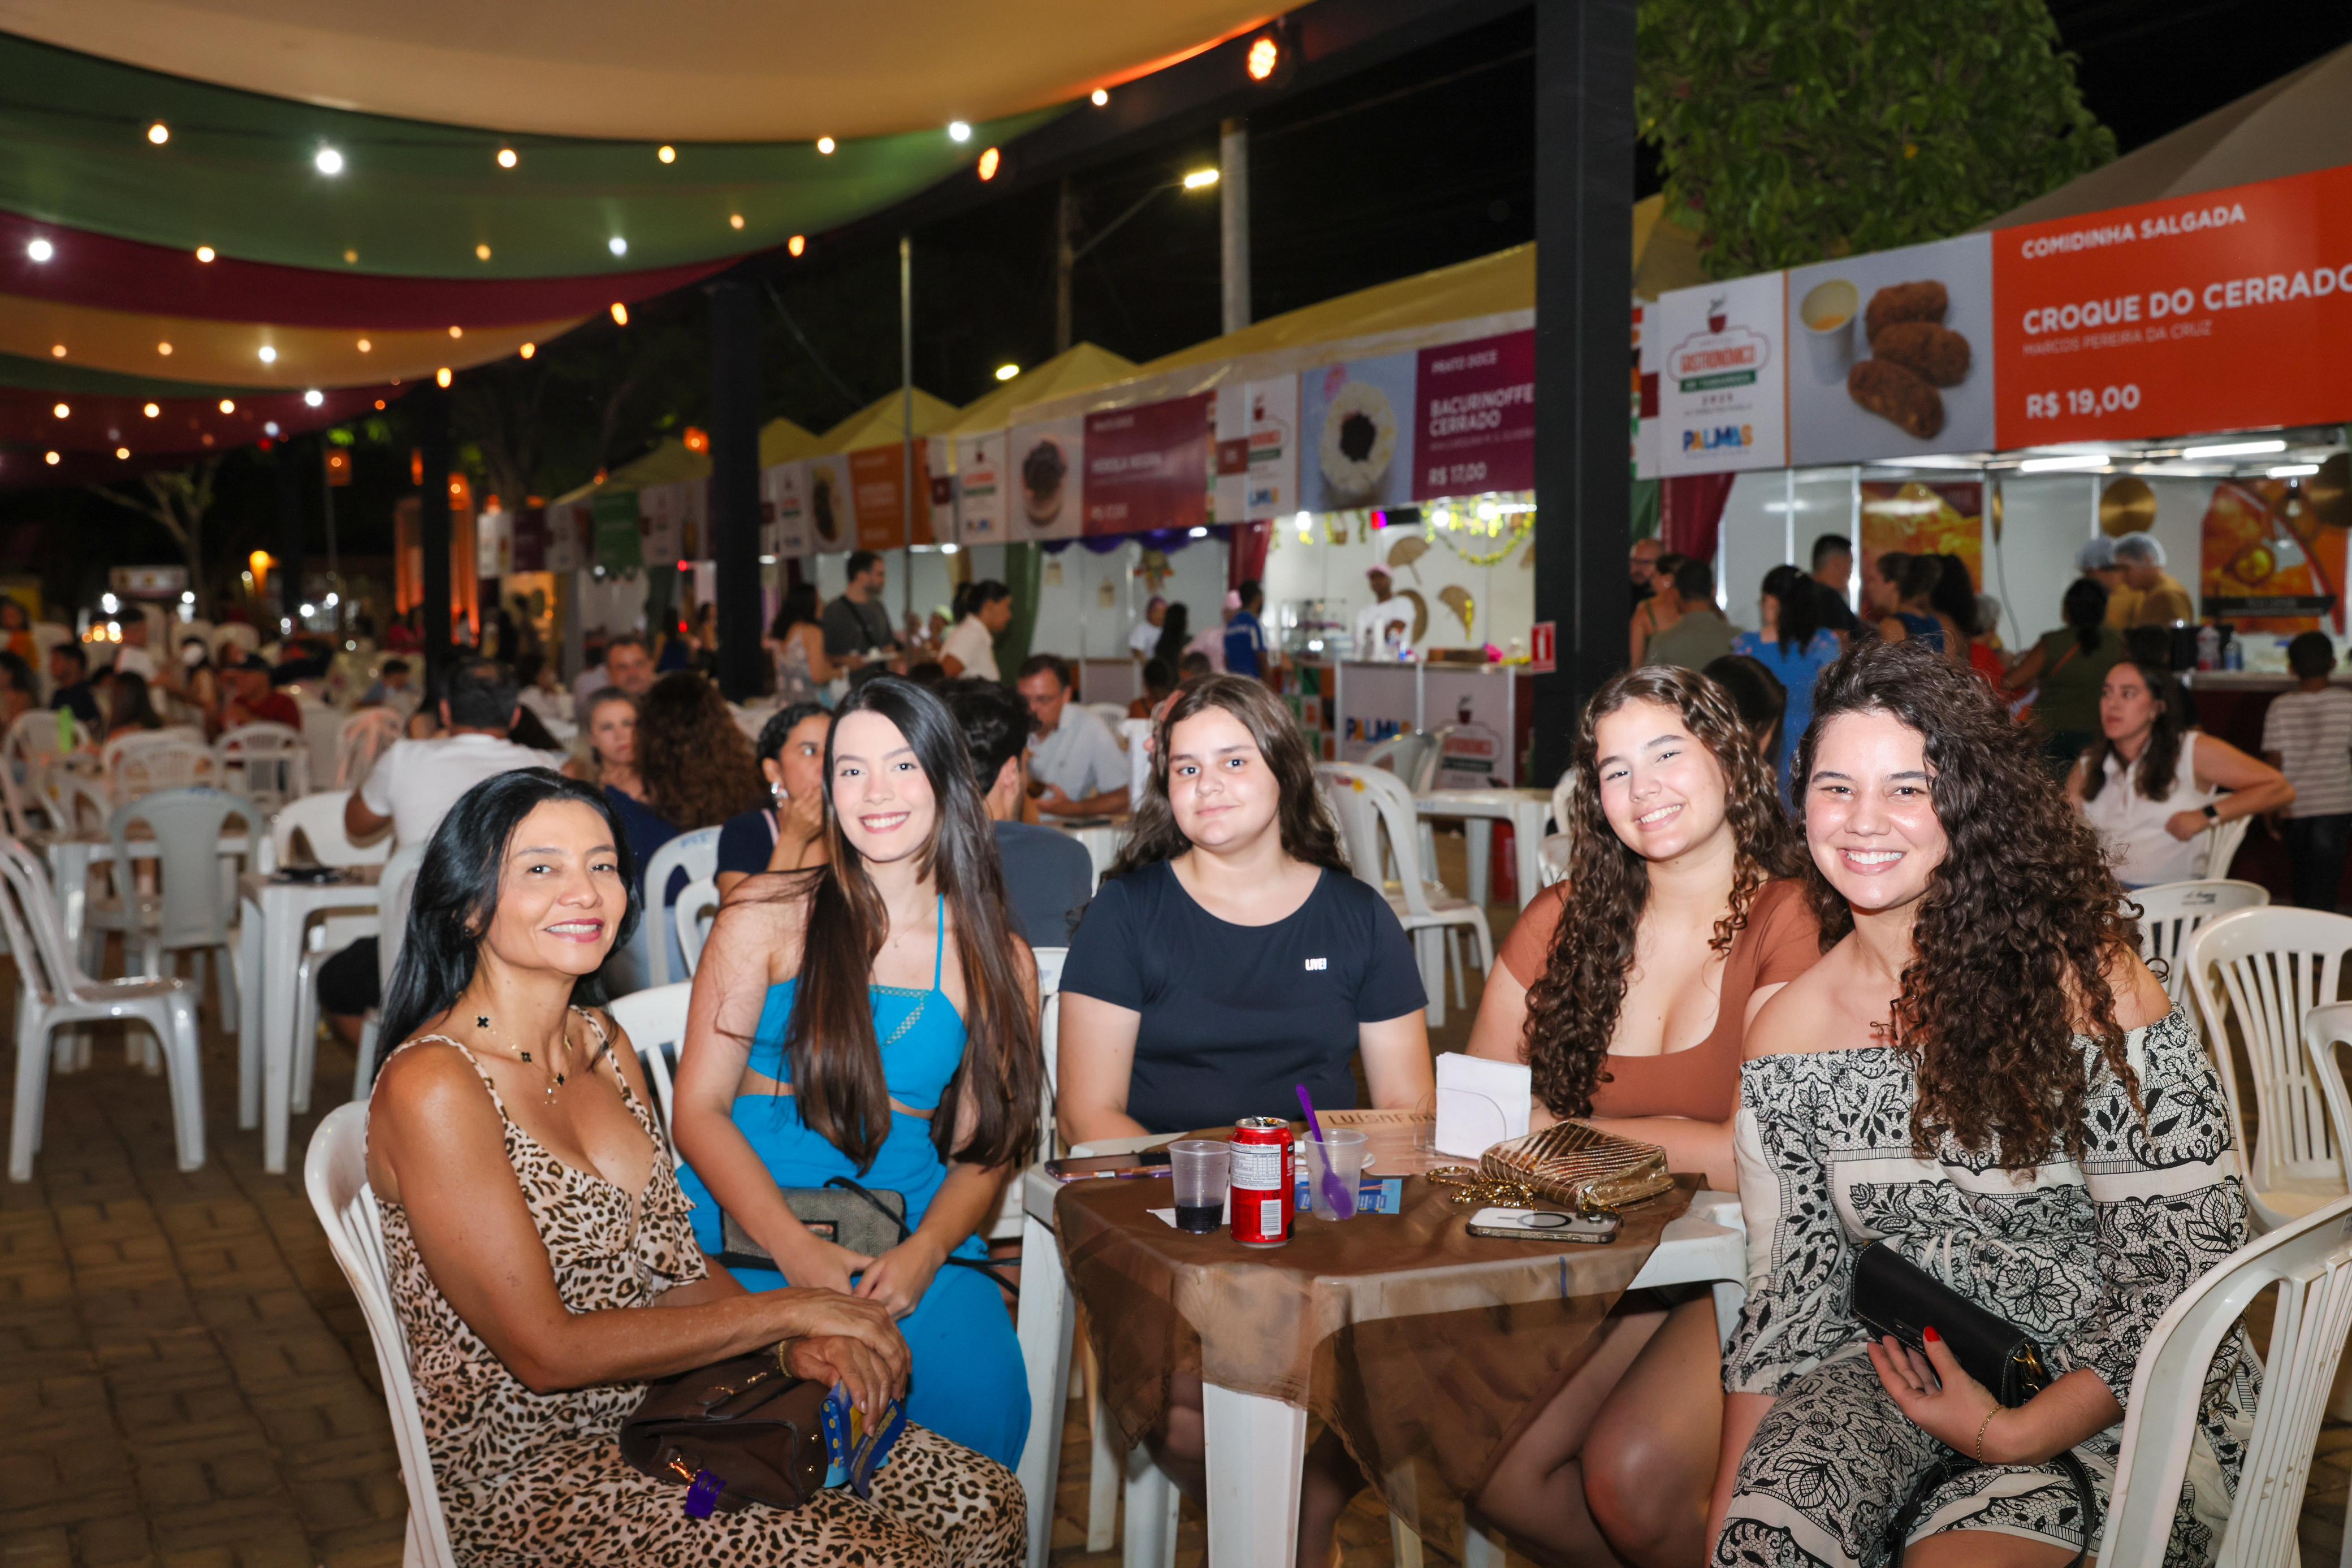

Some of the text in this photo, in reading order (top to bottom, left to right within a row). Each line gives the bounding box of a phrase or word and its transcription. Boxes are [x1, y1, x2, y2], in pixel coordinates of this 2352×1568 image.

[2021, 203, 2246, 259] COMIDINHA SALGADA
[2022, 294, 2142, 336] CROQUE
[2149, 288, 2195, 319] DO
[2022, 319, 2213, 357] MARCOS PEREIRA DA CRUZ
[2026, 383, 2141, 419] R$ 19,00
[1429, 409, 1502, 438] CERRADO
[1683, 424, 1753, 451] PALMAS
[1428, 466, 1447, 486] R$
